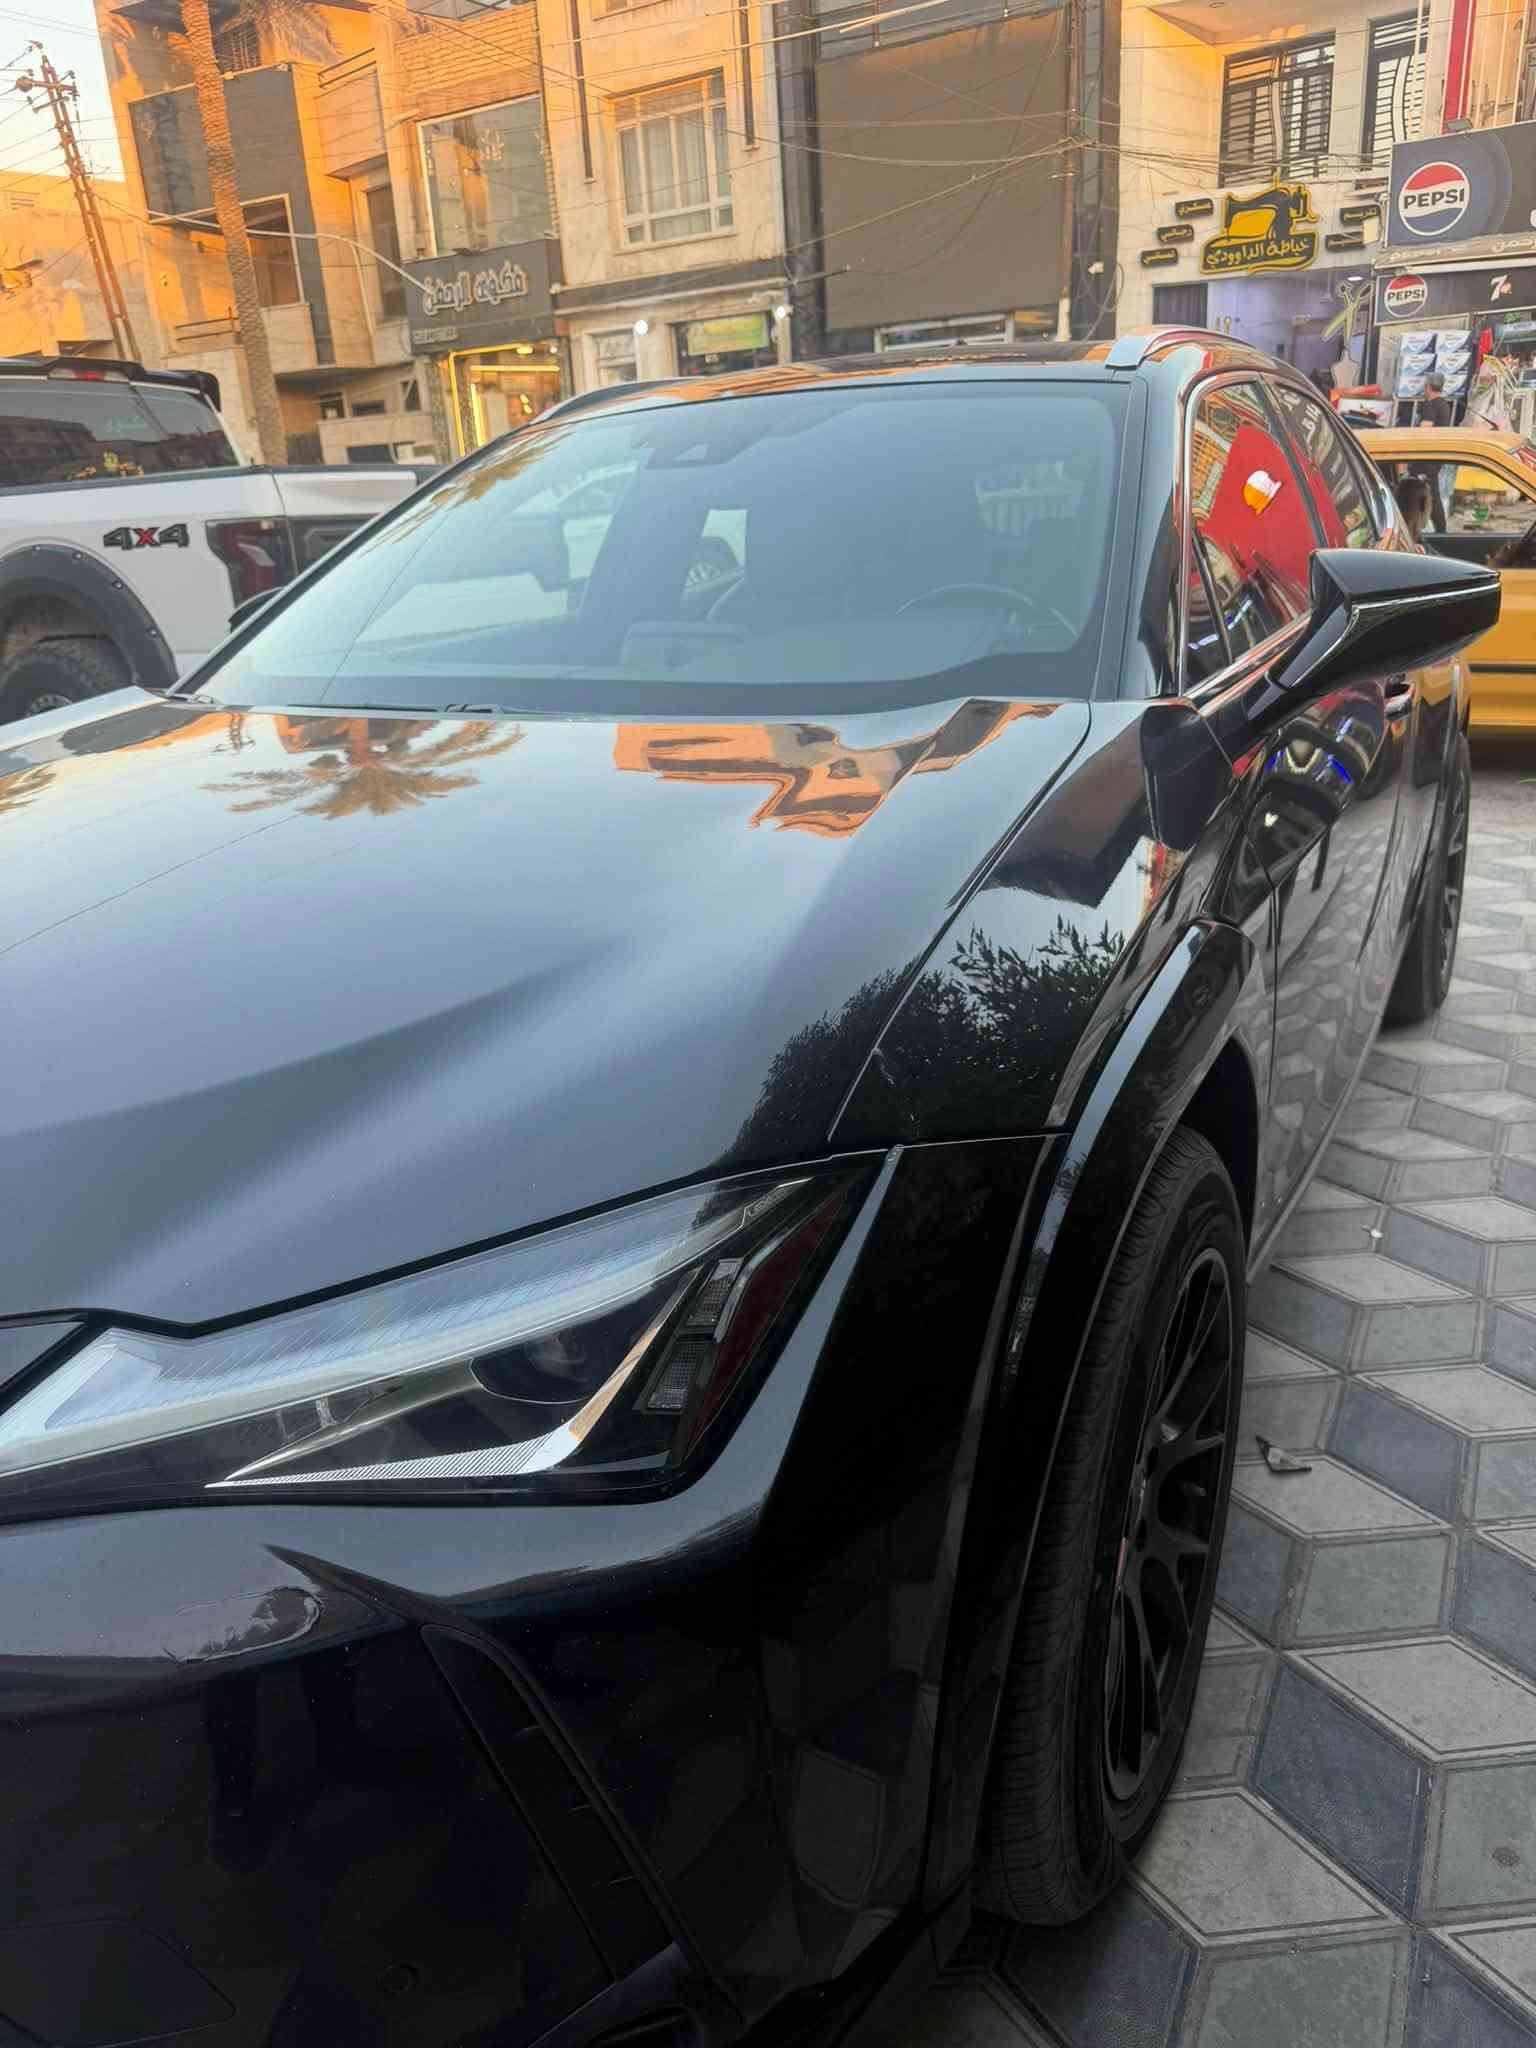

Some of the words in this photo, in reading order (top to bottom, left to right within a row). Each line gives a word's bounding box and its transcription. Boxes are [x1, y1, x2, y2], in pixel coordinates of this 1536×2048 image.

[1403, 188, 1465, 210] PEPSI
[1266, 238, 1311, 257] خياطة
[1387, 288, 1425, 301] PEPSI
